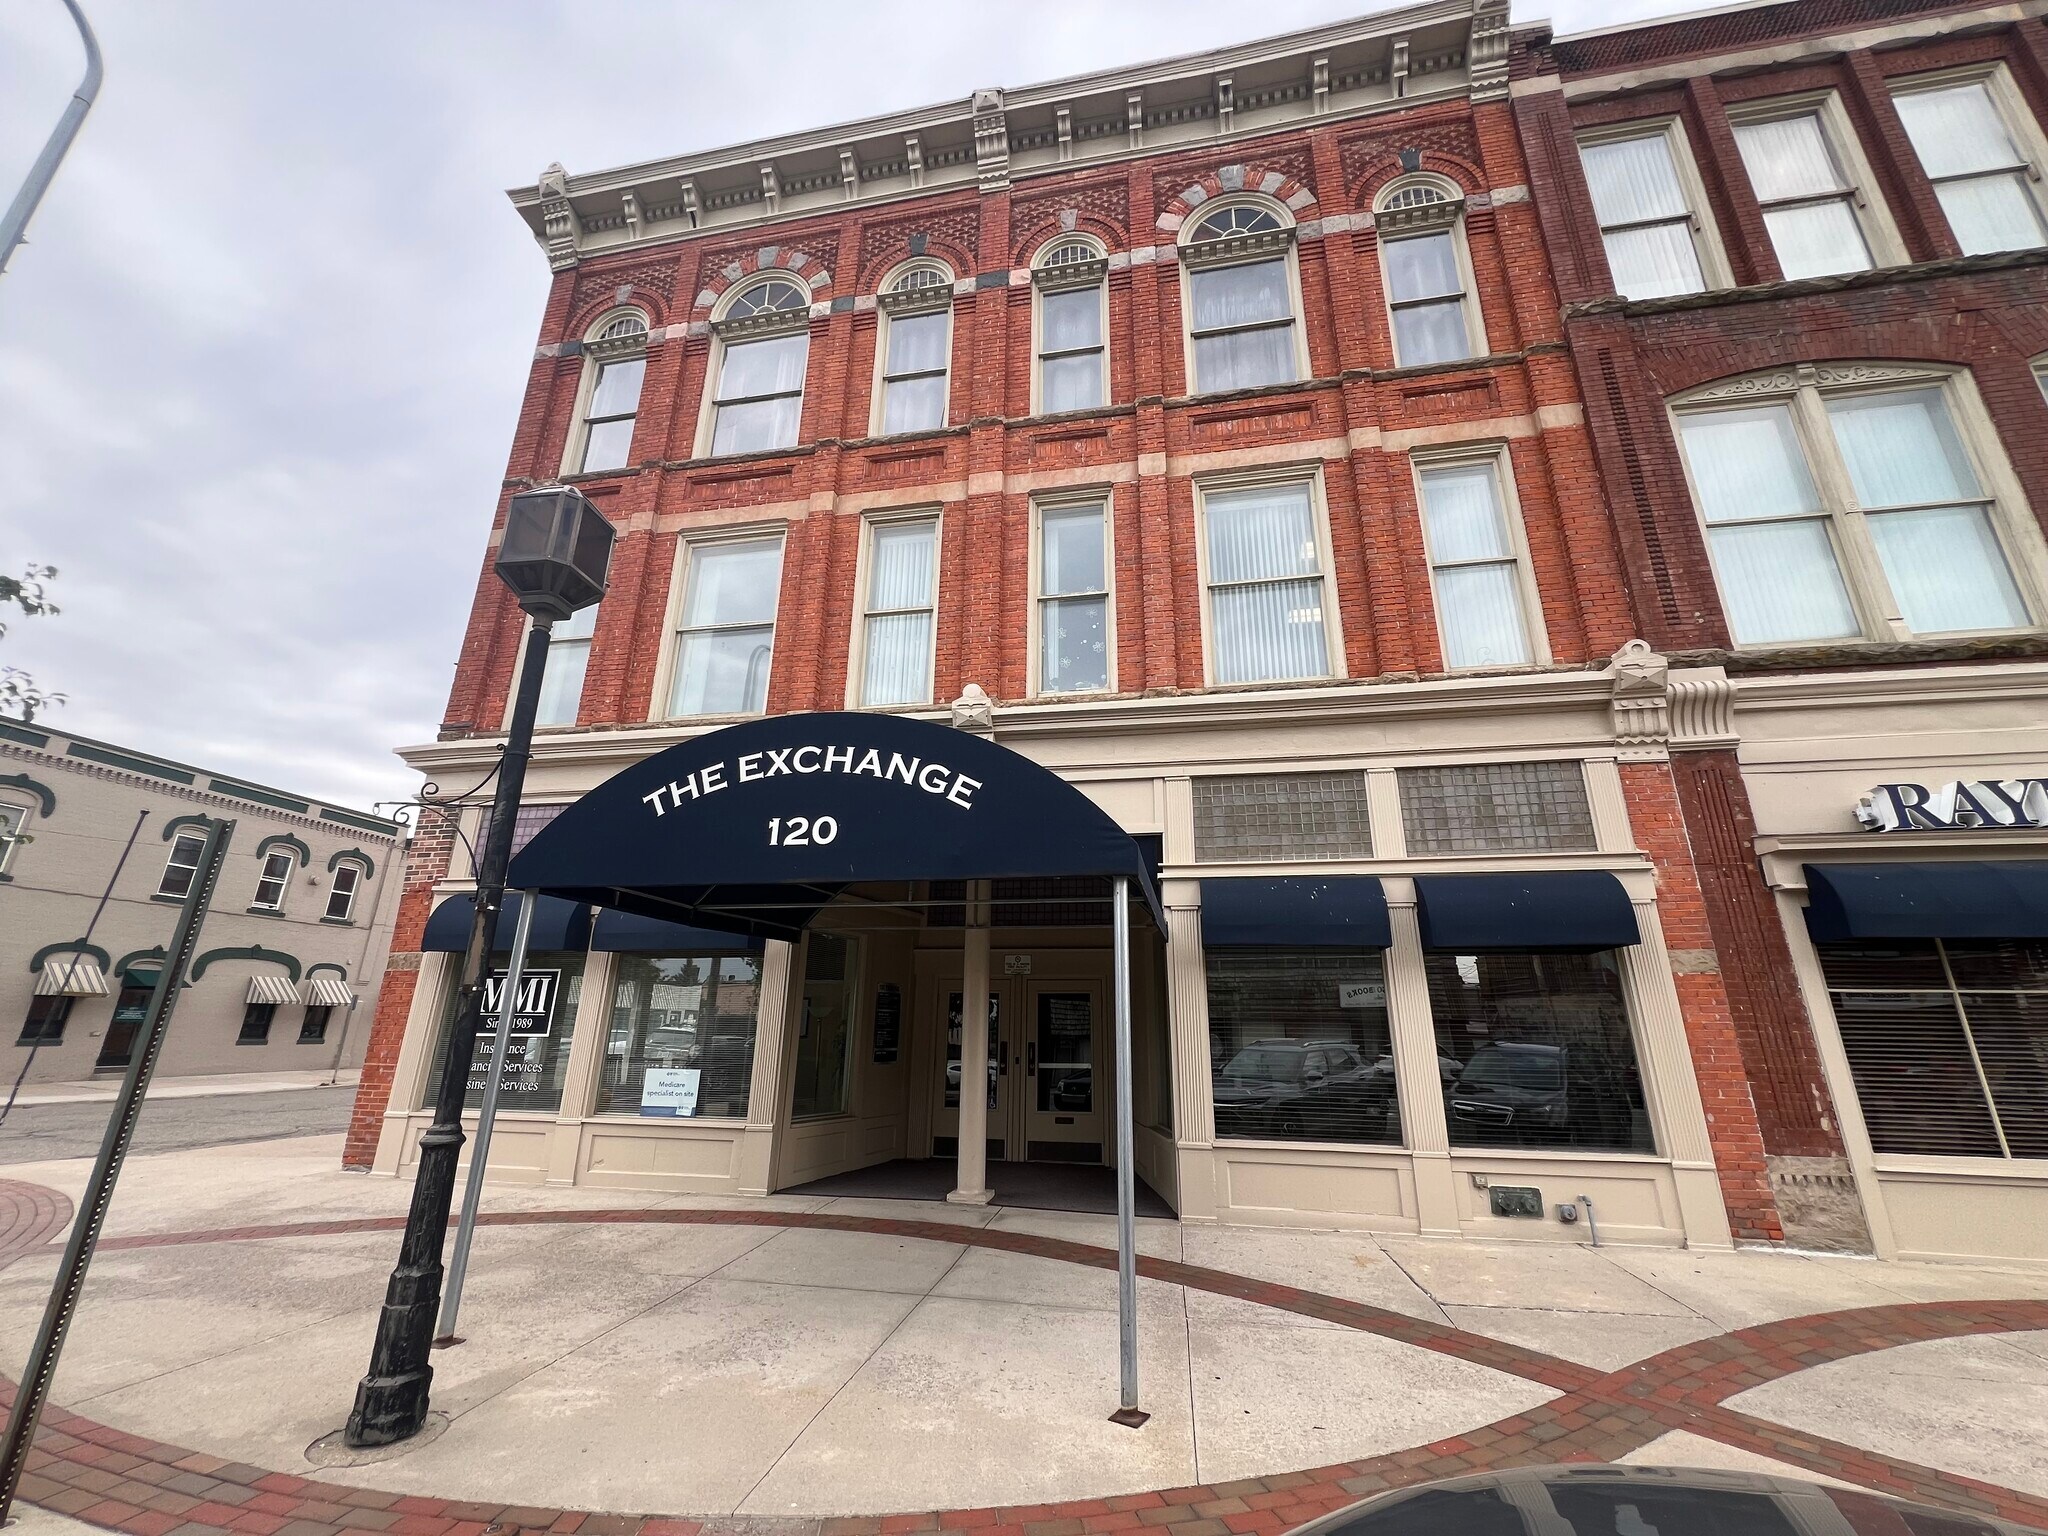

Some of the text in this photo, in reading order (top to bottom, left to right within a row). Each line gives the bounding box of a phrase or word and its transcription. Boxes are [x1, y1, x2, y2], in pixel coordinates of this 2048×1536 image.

[642, 745, 984, 818] THE EXCHANGE
[1877, 777, 2048, 830] RAY
[768, 815, 839, 847] 120
[480, 978, 552, 1012] MMI
[511, 1018, 533, 1029] 1989
[480, 1041, 526, 1054] Insnce
[647, 1090, 674, 1098] specialist
